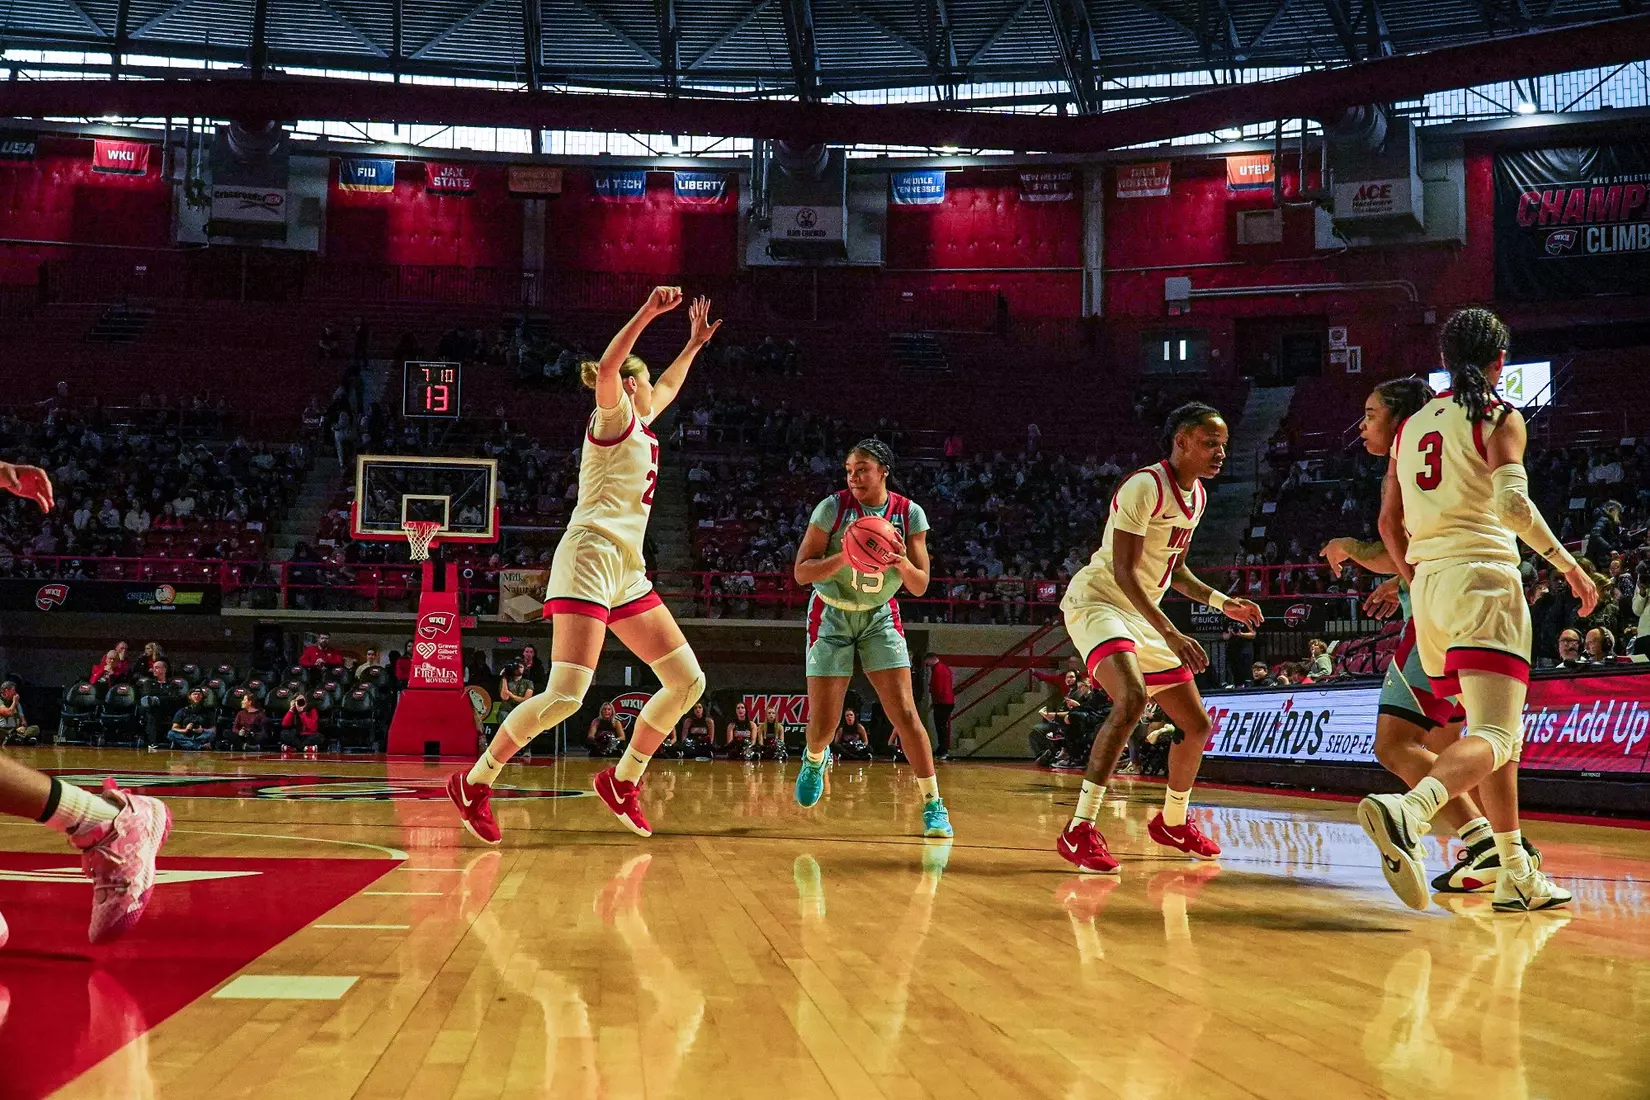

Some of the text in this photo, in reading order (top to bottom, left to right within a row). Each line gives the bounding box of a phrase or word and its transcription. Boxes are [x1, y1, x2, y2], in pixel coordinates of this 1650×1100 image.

[107, 150, 135, 161] WKU
[357, 167, 376, 178] FIU
[1239, 165, 1270, 175] UTEP
[433, 177, 471, 187] STATE
[595, 179, 643, 189] LA TECH
[678, 180, 726, 191] LIBERTY
[1592, 176, 1610, 184] WKU
[1352, 183, 1393, 201] ACE
[425, 384, 449, 412] 13
[1416, 430, 1444, 491] 3
[641, 469, 658, 506] 2
[865, 538, 892, 563] ELITE
[1158, 553, 1177, 588] 1
[428, 617, 447, 625] WKU
[620, 698, 644, 710] WKU
[1219, 709, 1330, 756] REWARDS
[1556, 699, 1616, 744] Add
[1612, 700, 1650, 755] Up
